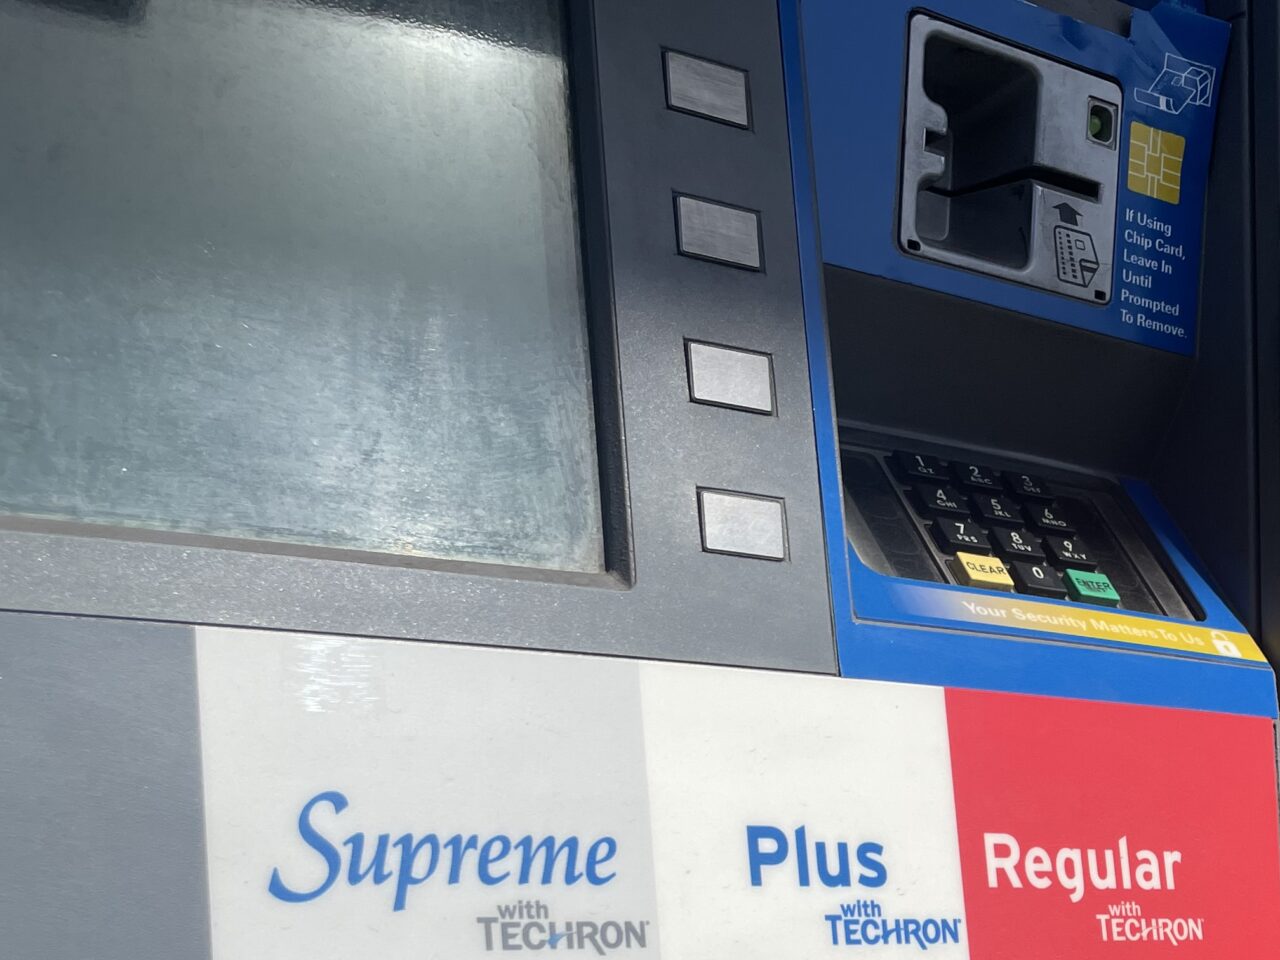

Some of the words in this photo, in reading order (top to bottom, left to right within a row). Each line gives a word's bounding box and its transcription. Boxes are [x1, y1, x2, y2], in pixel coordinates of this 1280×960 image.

[1126, 208, 1135, 222] If
[1138, 212, 1172, 237] Using
[1124, 229, 1152, 250] Chip
[1155, 239, 1186, 260] Card,
[1123, 248, 1158, 271] Leave
[1161, 260, 1172, 275] In
[1122, 269, 1152, 288] Until
[1121, 288, 1180, 316] Prompted
[1120, 308, 1134, 324] To
[1137, 313, 1187, 338] Remove.
[915, 455, 925, 467] 1
[969, 466, 981, 477] 2
[1022, 475, 1033, 486] 3
[936, 489, 947, 500] 4
[991, 499, 1001, 510] 5
[993, 509, 1012, 518] JKL
[1044, 508, 1053, 519] 6
[955, 523, 964, 534] 7
[1041, 517, 1067, 526] MNO
[956, 533, 978, 543] PRS
[1011, 532, 1023, 544] 8
[1012, 542, 1032, 552] TUV
[1063, 540, 1072, 552] 9
[1062, 550, 1087, 560] WXY
[966, 561, 1006, 575] CLEAR
[1032, 566, 1044, 579] 0
[1075, 577, 1112, 591] ENTER
[961, 600, 1008, 619] Your
[1011, 607, 1087, 632] Security
[1091, 618, 1156, 641] Matters
[1157, 628, 1177, 642] To
[1179, 632, 1205, 647] Us
[268, 790, 618, 913] Supreme
[745, 823, 888, 889] Plus
[983, 832, 1182, 903] Regular
[498, 899, 549, 920] with
[840, 899, 882, 918] with
[1108, 900, 1141, 917] with
[476, 915, 649, 952] TECHRON
[825, 913, 960, 951] TECHRON
[1095, 914, 1204, 946] TECHRON
